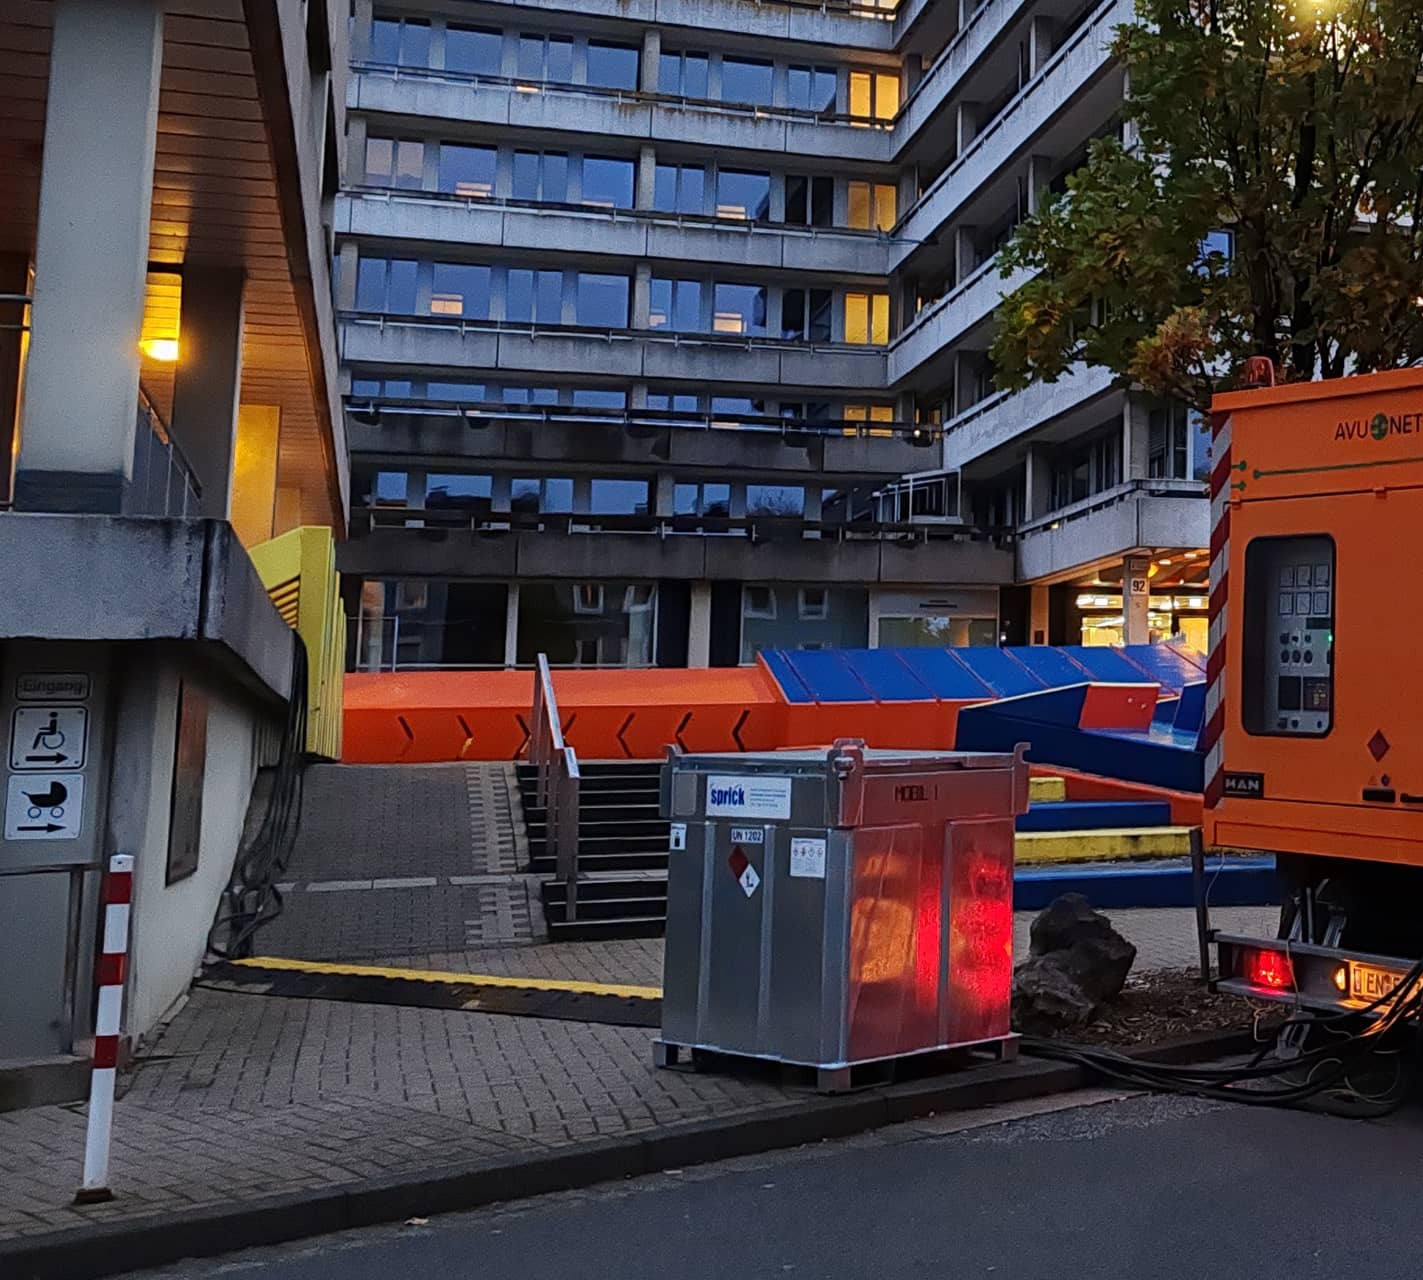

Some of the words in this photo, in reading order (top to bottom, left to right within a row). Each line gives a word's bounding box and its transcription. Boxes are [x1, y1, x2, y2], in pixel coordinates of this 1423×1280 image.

[1334, 420, 1368, 440] AVU
[1132, 580, 1145, 592] 92
[23, 680, 82, 695] Eingang
[1225, 778, 1260, 792] MAN
[711, 786, 745, 806] sprick
[732, 831, 743, 841] UN
[744, 831, 762, 842] 1202
